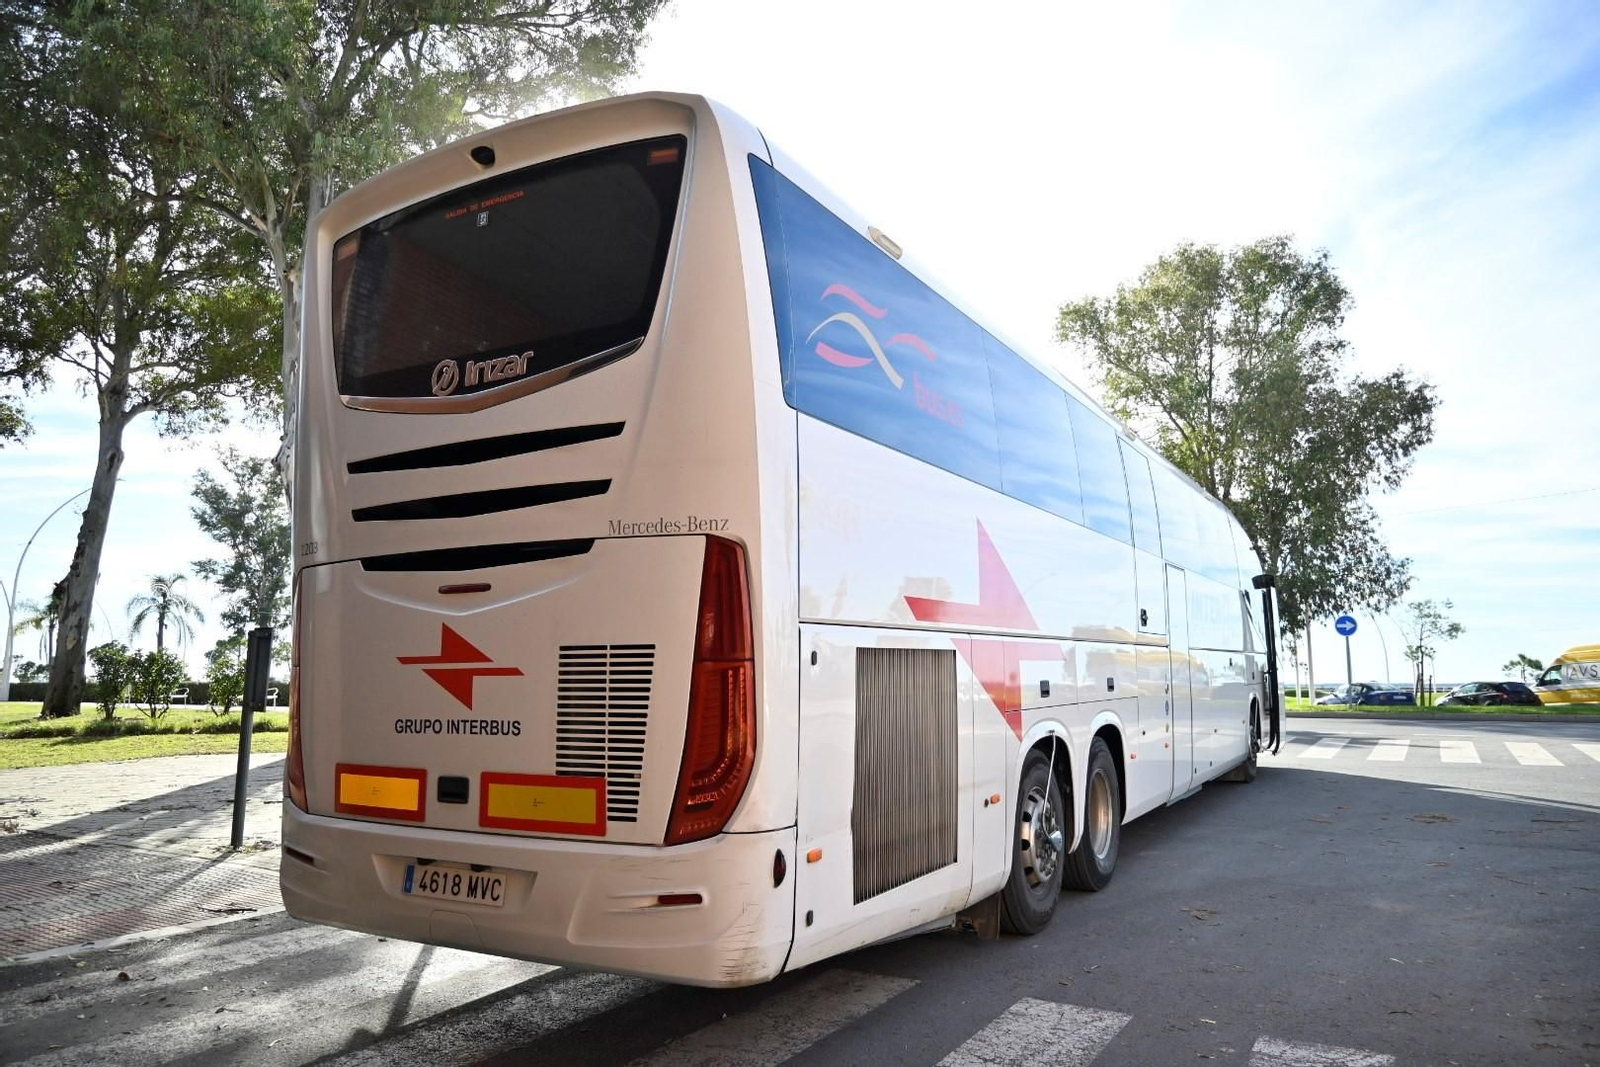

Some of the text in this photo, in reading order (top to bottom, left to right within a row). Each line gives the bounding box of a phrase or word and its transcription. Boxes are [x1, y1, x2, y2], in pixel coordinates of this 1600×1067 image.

[608, 515, 729, 536] Mercedes-Benz
[394, 718, 522, 737] GRUPO INTERBUS
[419, 869, 502, 902] 4618 MVC
